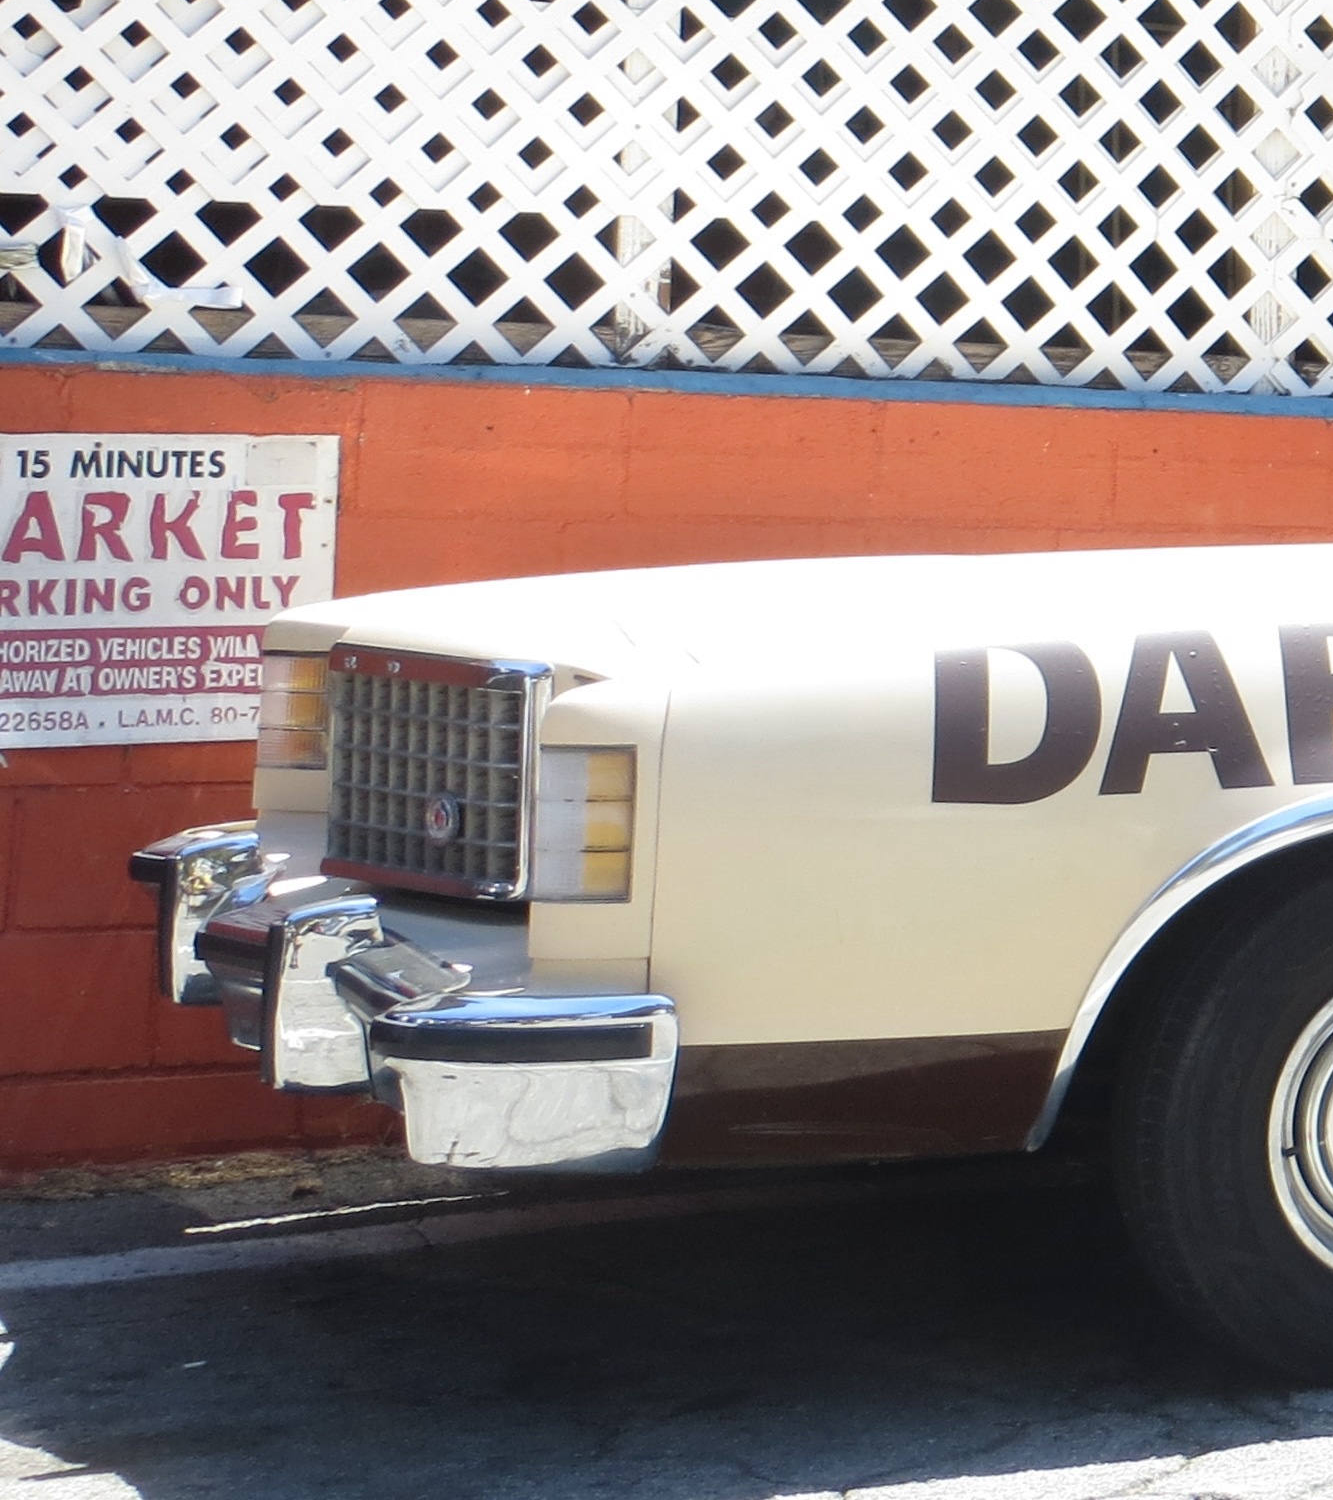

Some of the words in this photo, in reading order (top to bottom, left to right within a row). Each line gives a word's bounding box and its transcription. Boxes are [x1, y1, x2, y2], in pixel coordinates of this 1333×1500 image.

[18, 450, 50, 478] 15
[69, 450, 226, 479] MINUTES
[1, 489, 317, 563] ARKET
[179, 575, 300, 612] ONLY
[98, 636, 201, 662] VEHICLES
[207, 634, 260, 660] WILL
[1, 667, 60, 694] AWAY
[61, 665, 94, 695] AT
[99, 665, 197, 690] OWNER'S
[0, 711, 90, 732] 22658A
[118, 707, 200, 729] L.A.M.C.
